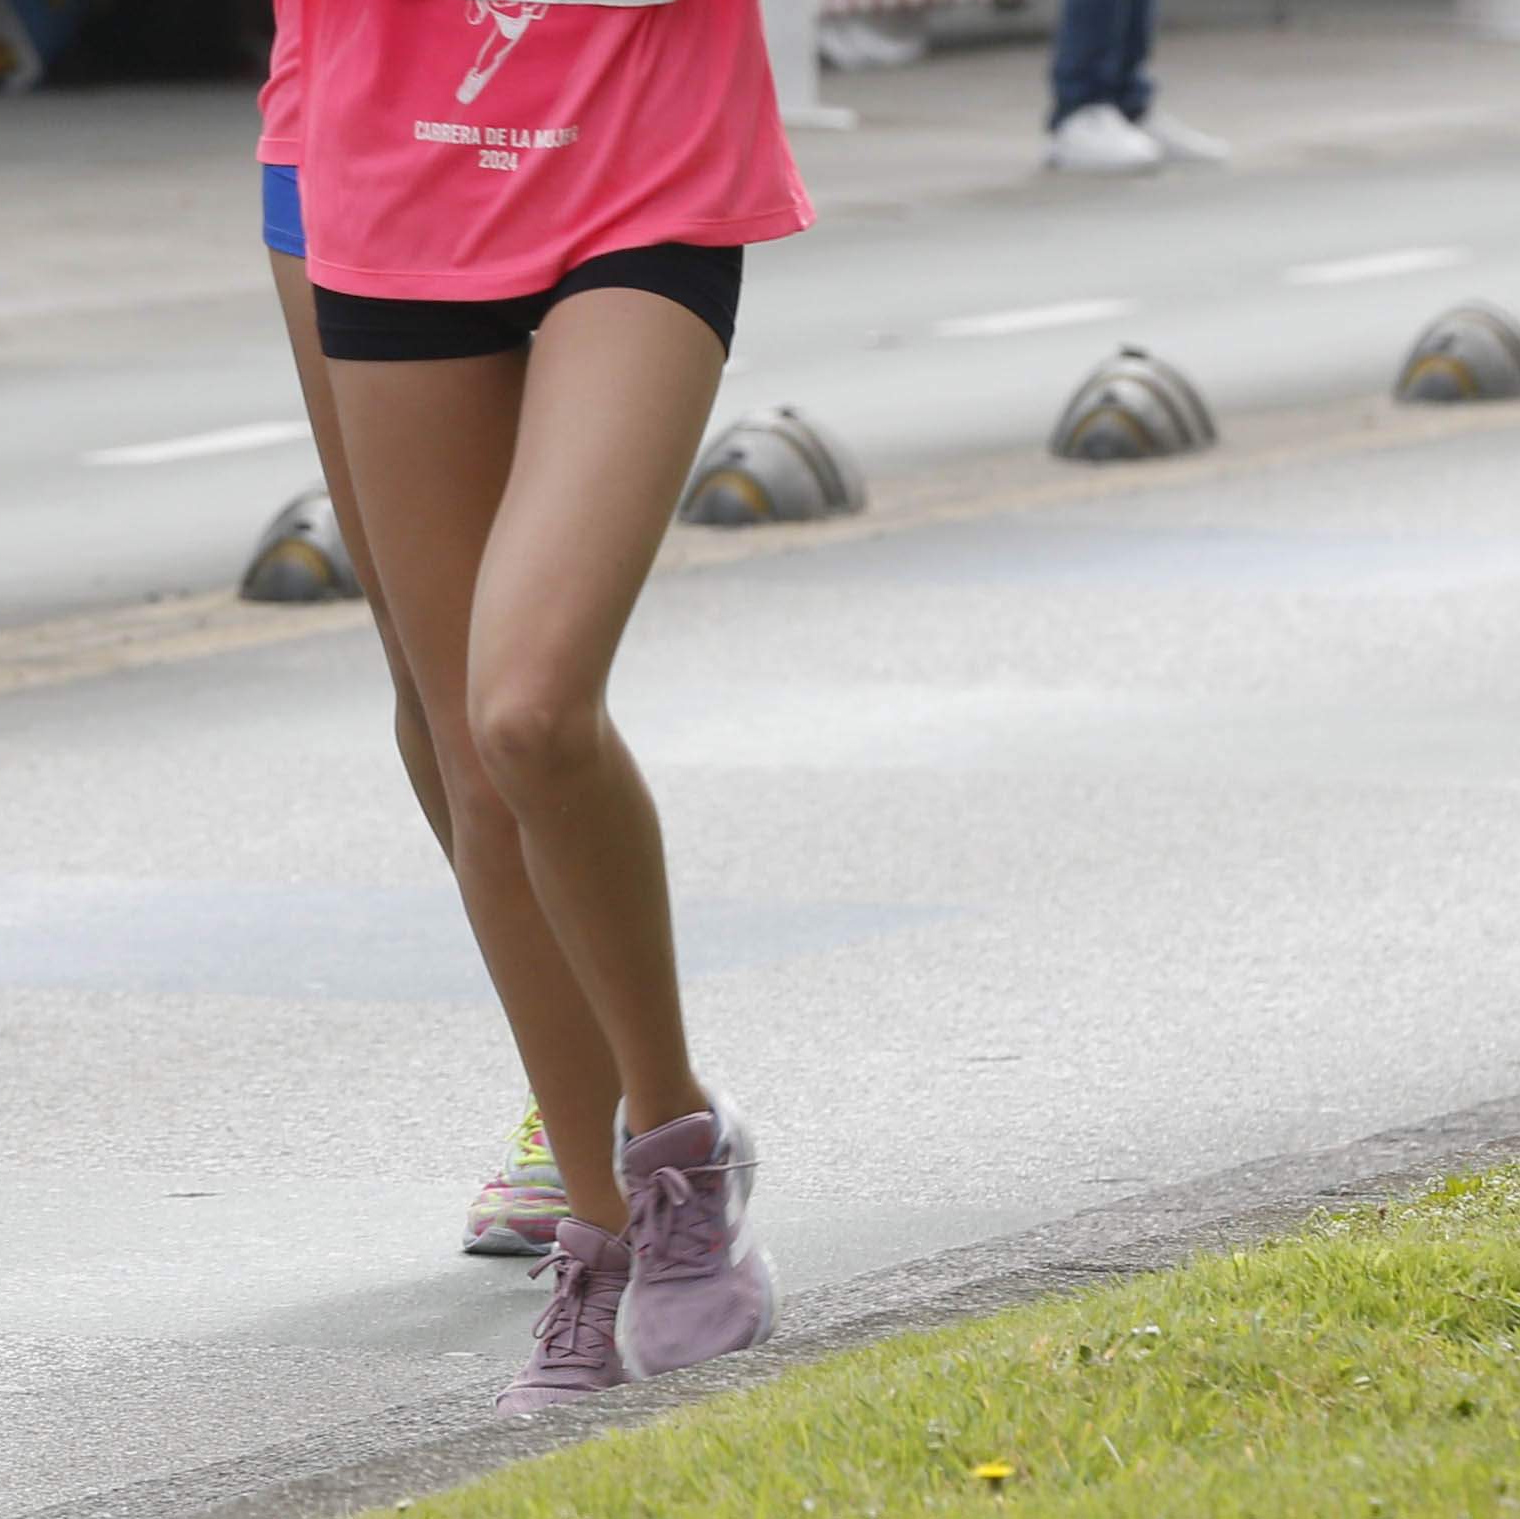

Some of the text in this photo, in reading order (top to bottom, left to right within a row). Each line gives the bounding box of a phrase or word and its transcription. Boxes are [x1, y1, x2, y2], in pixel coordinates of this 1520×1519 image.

[414, 119, 482, 145] CARRERA
[485, 127, 508, 147] DE
[511, 128, 531, 149] LA
[478, 148, 519, 172] 2024
